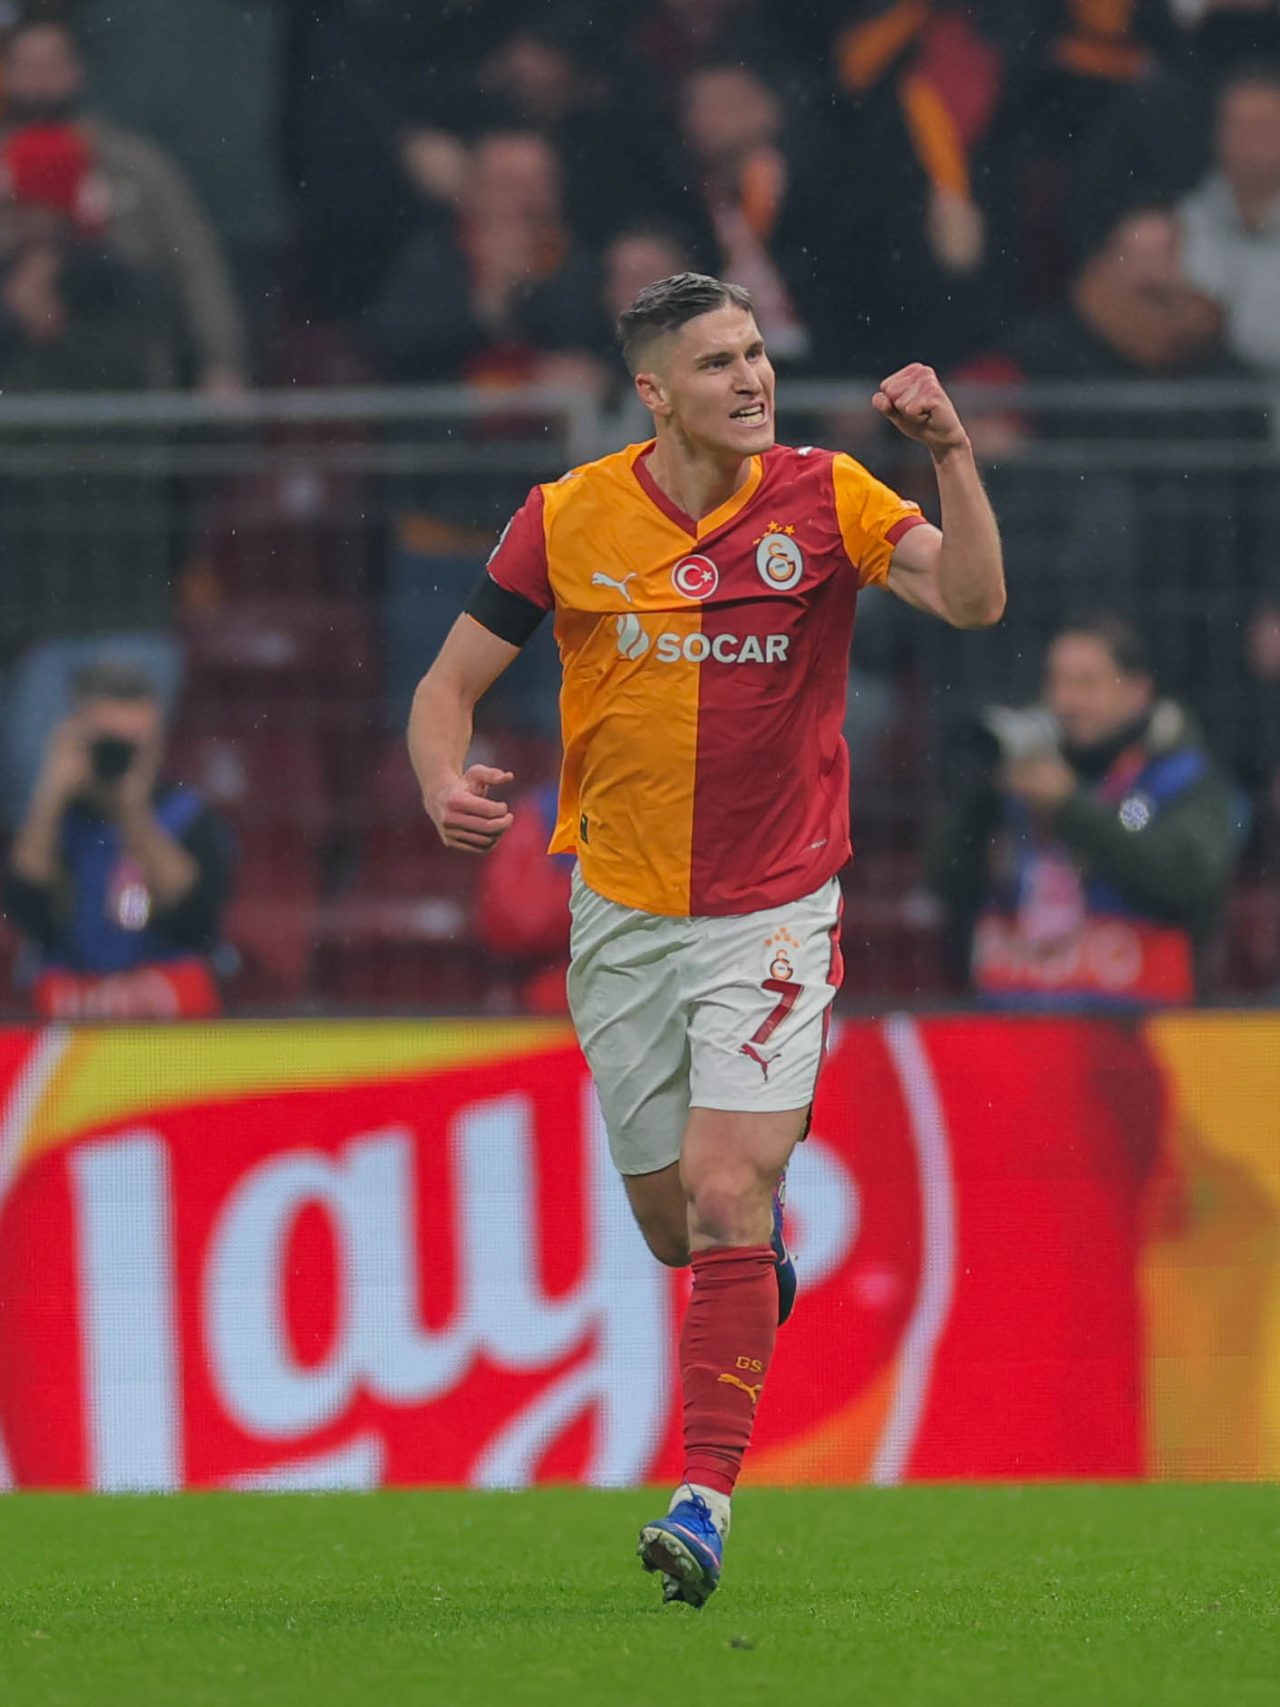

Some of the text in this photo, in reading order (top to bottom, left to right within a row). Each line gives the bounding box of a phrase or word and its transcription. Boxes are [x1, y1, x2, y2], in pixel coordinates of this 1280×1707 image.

[656, 632, 790, 664] SOCAR
[750, 977, 805, 1045] 7
[735, 1355, 763, 1373] GS
